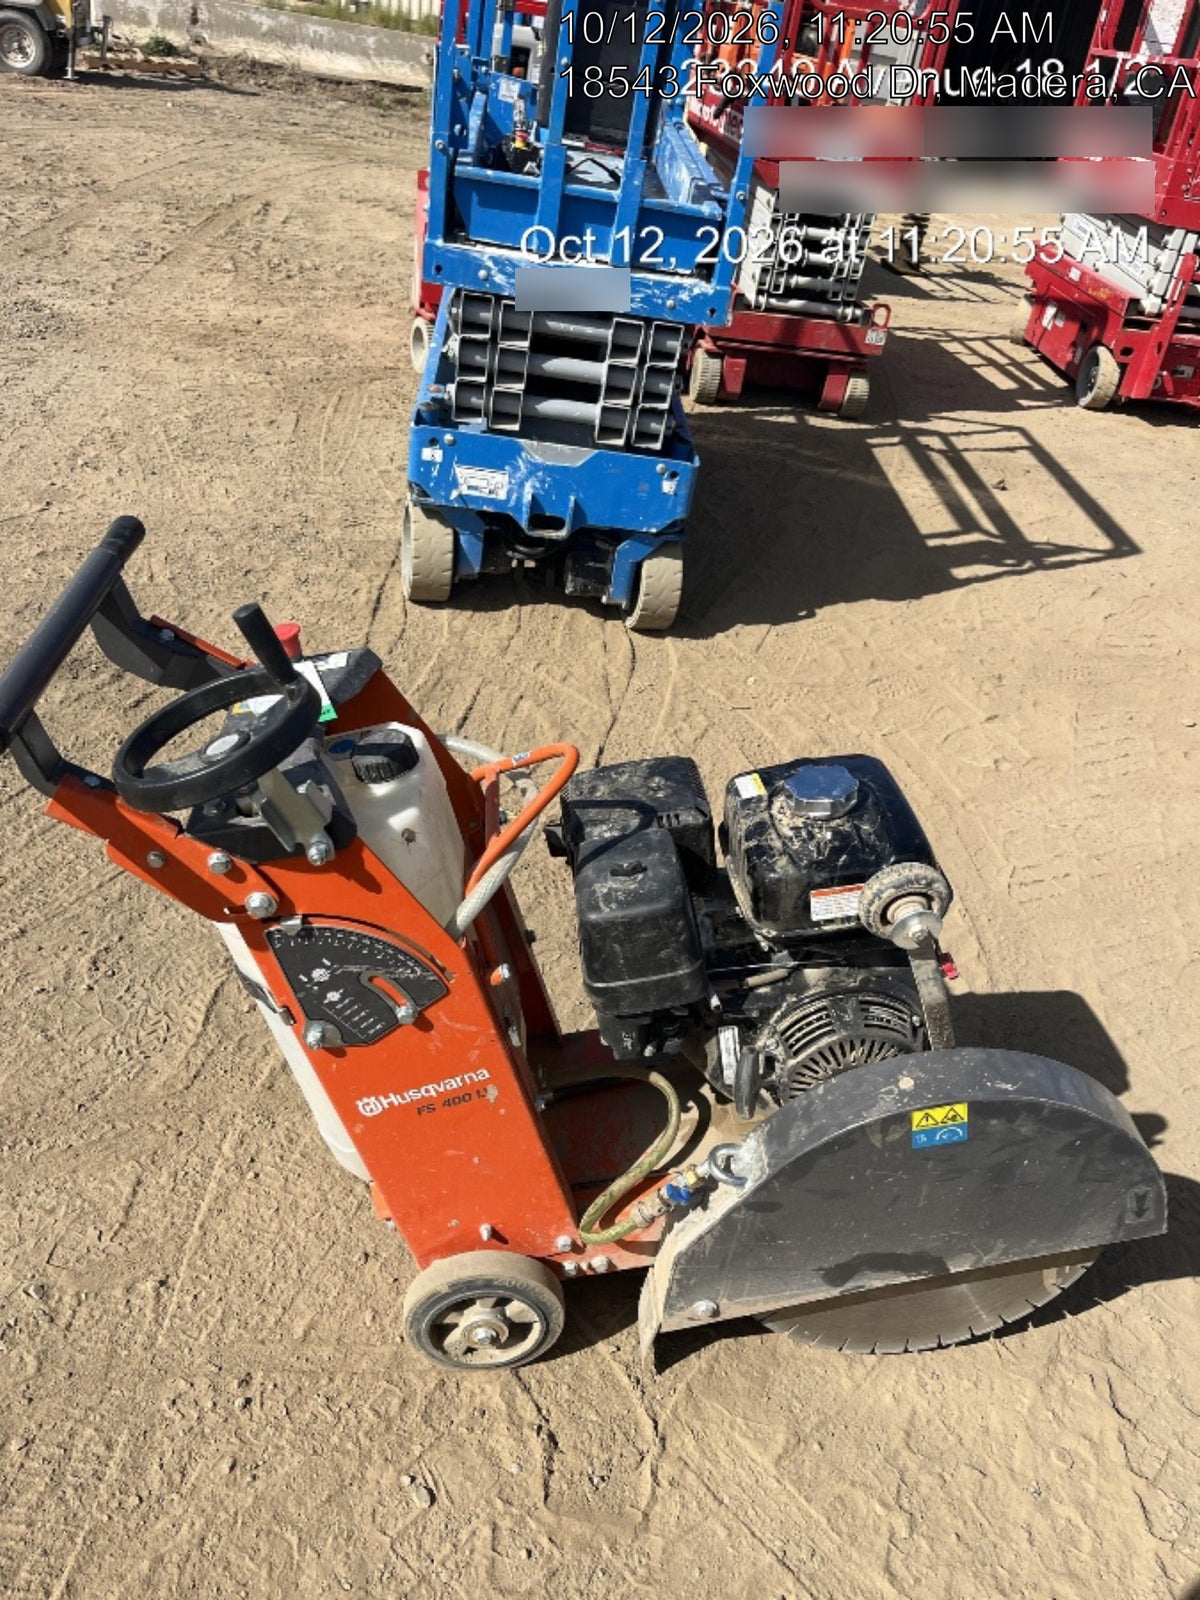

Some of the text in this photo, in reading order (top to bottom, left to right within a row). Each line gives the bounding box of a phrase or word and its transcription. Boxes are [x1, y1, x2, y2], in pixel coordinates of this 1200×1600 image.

[378, 1067, 491, 1110] Husqvarna
[416, 1102, 437, 1117] FS
[441, 1092, 473, 1109] 400
